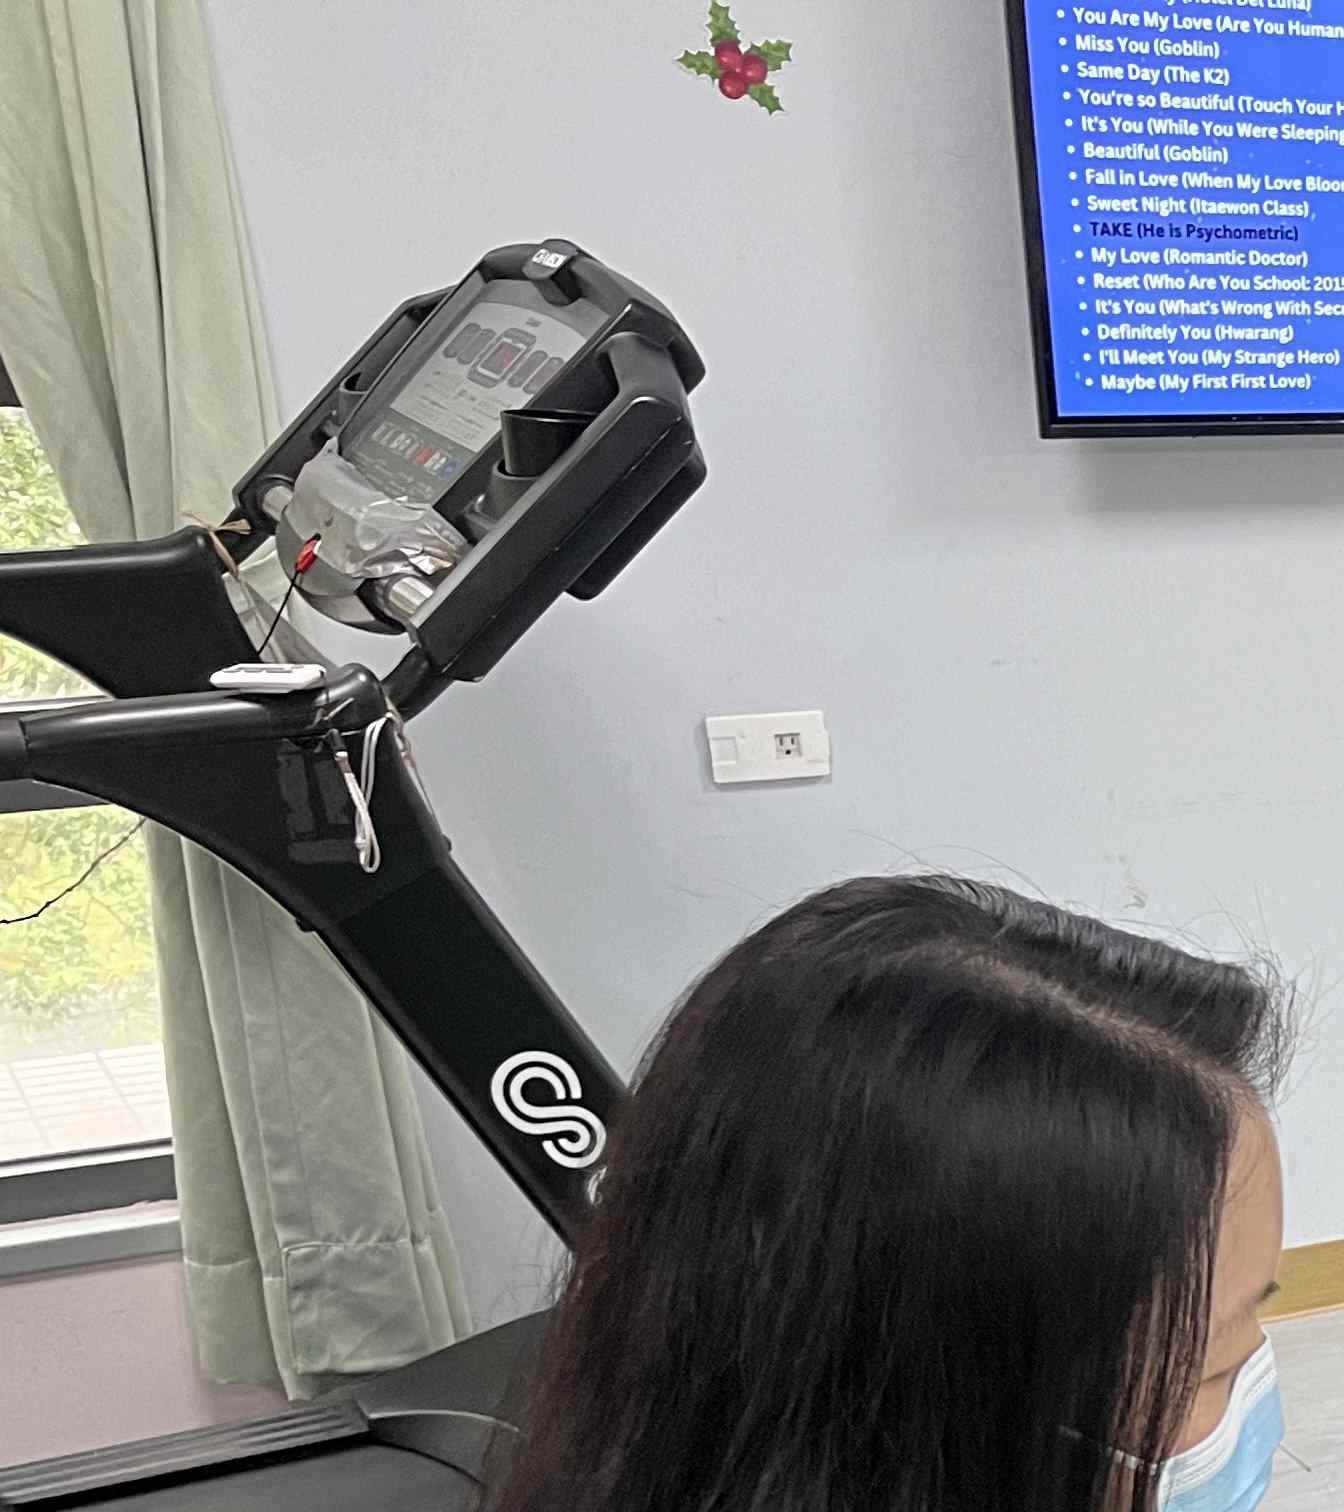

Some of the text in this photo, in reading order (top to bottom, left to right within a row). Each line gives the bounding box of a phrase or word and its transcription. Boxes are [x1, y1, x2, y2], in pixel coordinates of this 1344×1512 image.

[1073, 7, 1106, 24] You
[1111, 9, 1140, 26] Are
[1144, 11, 1169, 32] My
[1173, 13, 1212, 30] Love
[1216, 15, 1250, 32] (Are
[1253, 18, 1284, 34] You
[1076, 34, 1219, 59] Miss You (Goblin)
[1077, 62, 1229, 86] Same Day (The K2)
[1078, 88, 1133, 106] You're
[1137, 95, 1156, 107] so
[1160, 92, 1235, 111] Beautiful
[1238, 96, 1293, 113] (Touch
[1296, 99, 1333, 115] Your
[1082, 116, 1108, 132] It's
[1110, 117, 1143, 133] You
[1147, 118, 1199, 136] (While
[1202, 121, 1233, 137] You
[1236, 123, 1278, 139] Were
[1084, 142, 1228, 164] Beautiful (Goblin)
[1086, 168, 1116, 184] Fall
[1119, 170, 1135, 185] in
[1139, 171, 1178, 187] Love
[1182, 172, 1233, 189] (When
[1237, 174, 1261, 193] My
[1265, 175, 1302, 191] Love
[1088, 195, 1309, 217] Sweet Night (Itaewon Class)
[1090, 222, 1298, 242] TAKE (He is Psychometric)
[1092, 248, 1308, 267] My Love (Romantic Doctor)
[1094, 273, 1140, 289] Reset
[1143, 273, 1185, 290] (Who
[1189, 275, 1216, 289] Are
[1219, 275, 1250, 290] You
[1096, 299, 1121, 314] It's
[1123, 299, 1156, 314] You
[1159, 299, 1219, 315] (What's
[1221, 300, 1273, 319] Wrong
[1275, 300, 1311, 315] With
[1098, 324, 1294, 344] Definitely You (Hwarang)
[1100, 349, 1340, 368] I'll Meet You (My Strange Hero)
[1102, 374, 1311, 393] Maybe (My First First Love)
